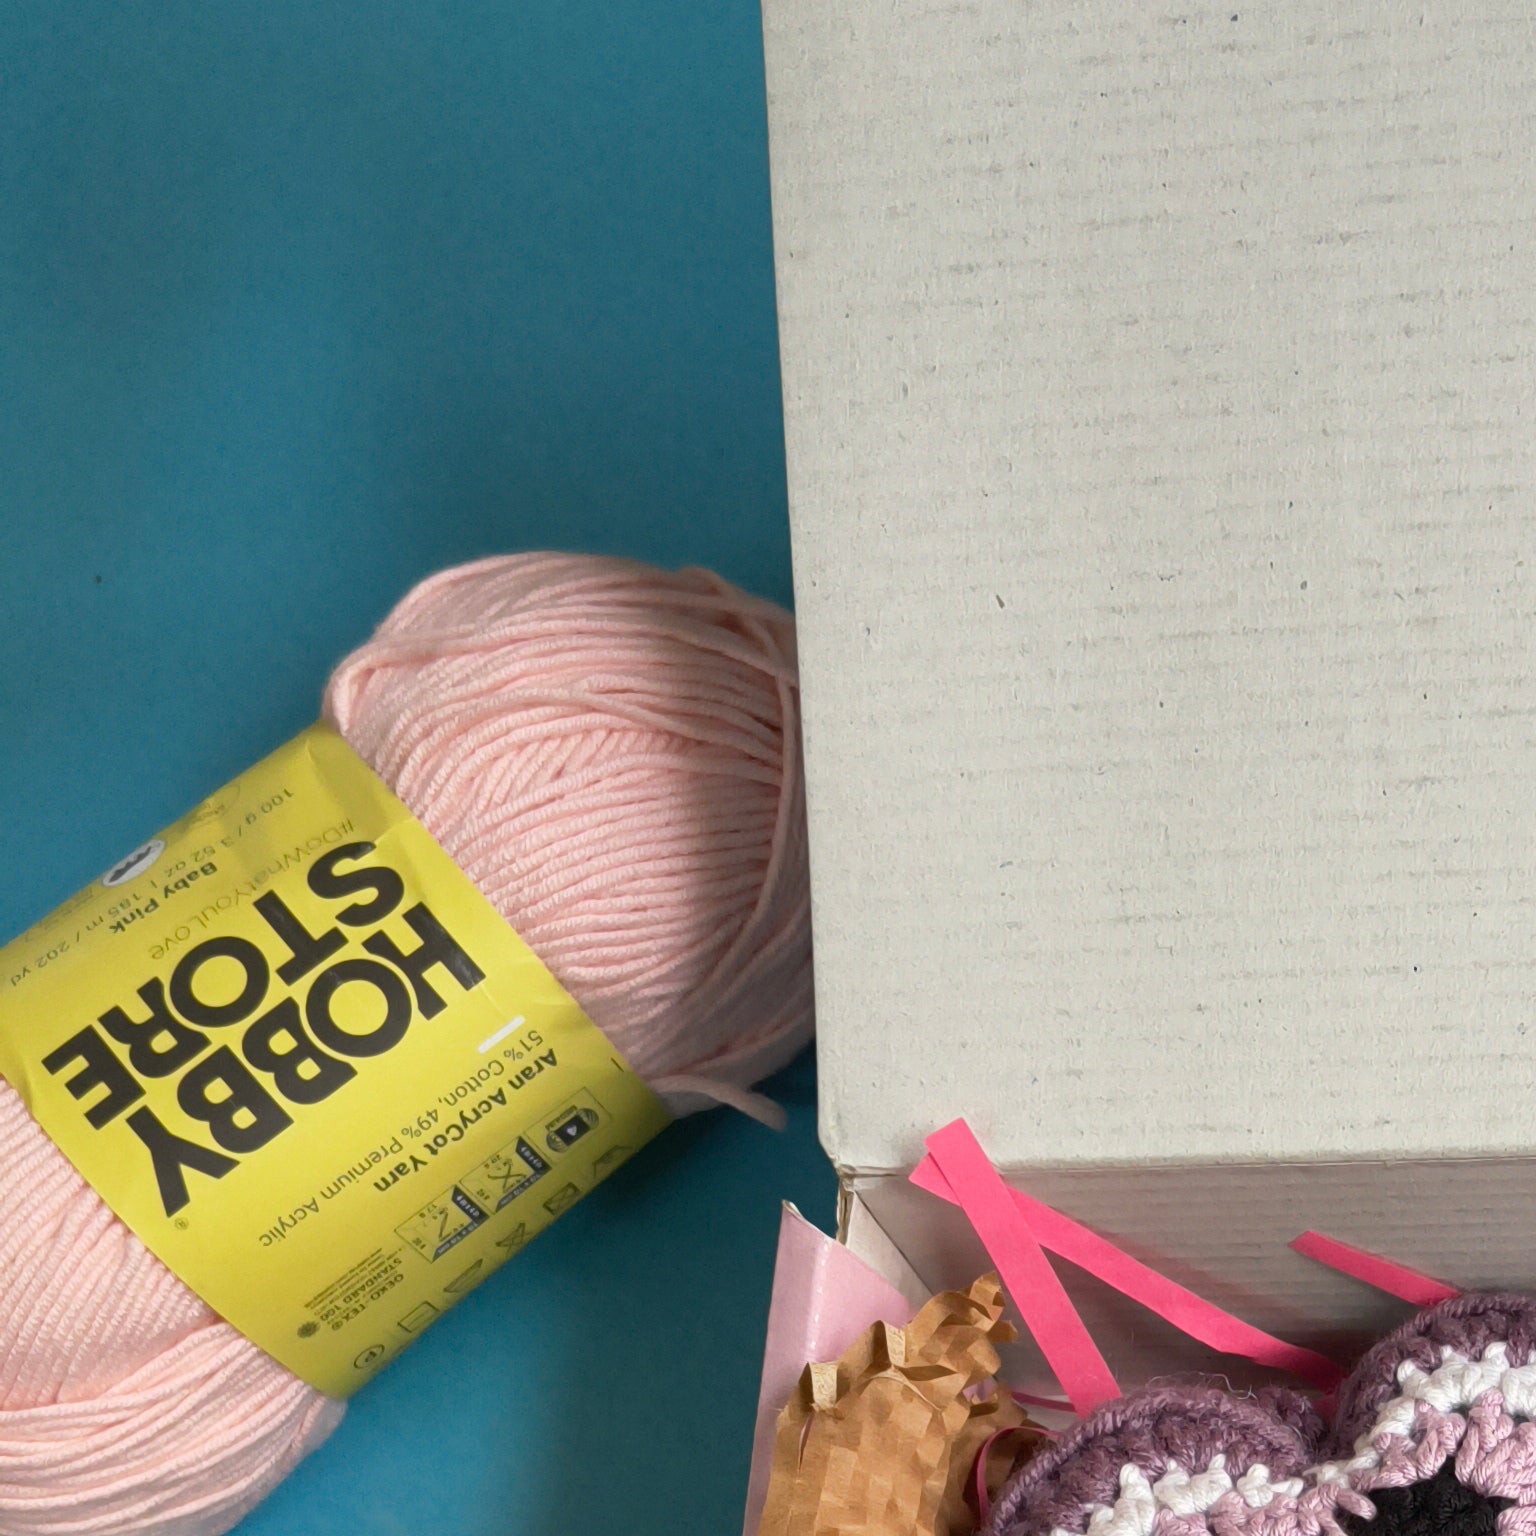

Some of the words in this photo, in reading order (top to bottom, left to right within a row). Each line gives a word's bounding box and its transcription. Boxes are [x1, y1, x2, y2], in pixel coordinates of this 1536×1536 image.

[257, 788, 294, 815] 100
[190, 836, 235, 863] 352
[163, 862, 218, 899] Baby
[109, 897, 160, 934] Pink
[31, 937, 70, 968] 202
[41, 838, 404, 1130] STORE
[125, 901, 486, 1218] HOBBY
[503, 1030, 544, 1061] 51%
[438, 1060, 504, 1106] Cotton,
[508, 1048, 560, 1090] Aran
[401, 1109, 438, 1139] 49%
[423, 1087, 507, 1156] AcryCot
[320, 1136, 403, 1199] Premium
[373, 1155, 428, 1192] Yarn
[259, 1197, 319, 1246] Acrylic
